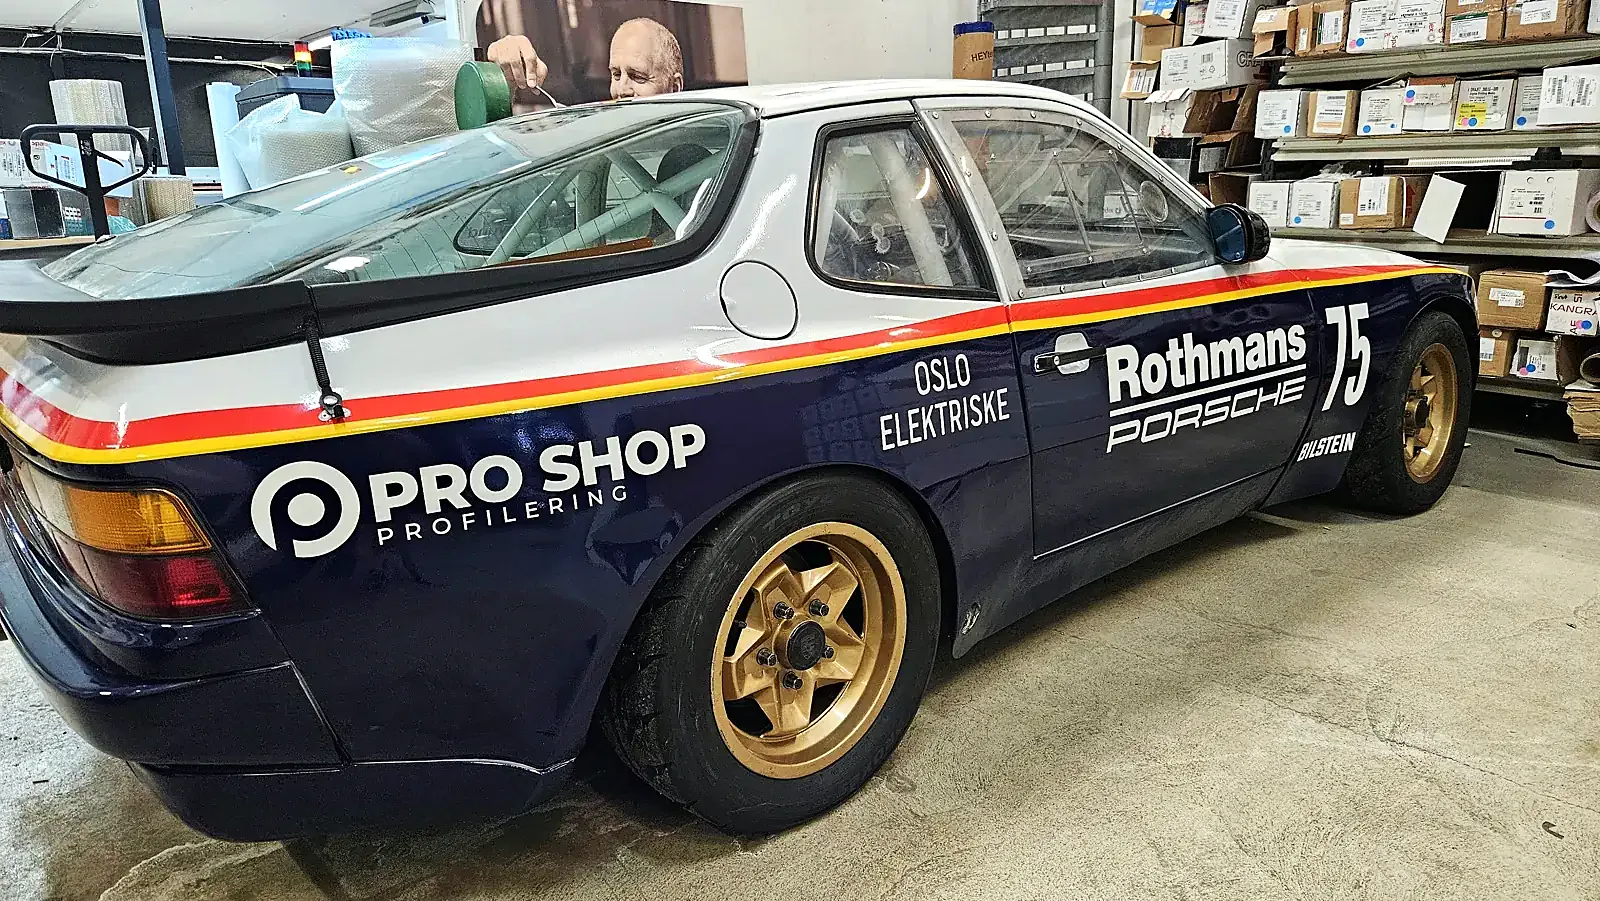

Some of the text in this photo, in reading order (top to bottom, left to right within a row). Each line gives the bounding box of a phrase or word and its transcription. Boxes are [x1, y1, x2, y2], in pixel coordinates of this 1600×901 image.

[914, 353, 971, 396] OSLO
[1105, 324, 1307, 404] Rothmans
[1321, 302, 1371, 411] 75
[880, 387, 1011, 451] ELEKTRISKE
[1106, 376, 1307, 453] PORSCHE
[1296, 432, 1356, 463] BILSTEIN
[368, 423, 706, 523] PRO SHOP
[377, 485, 628, 546] PROFILERING
